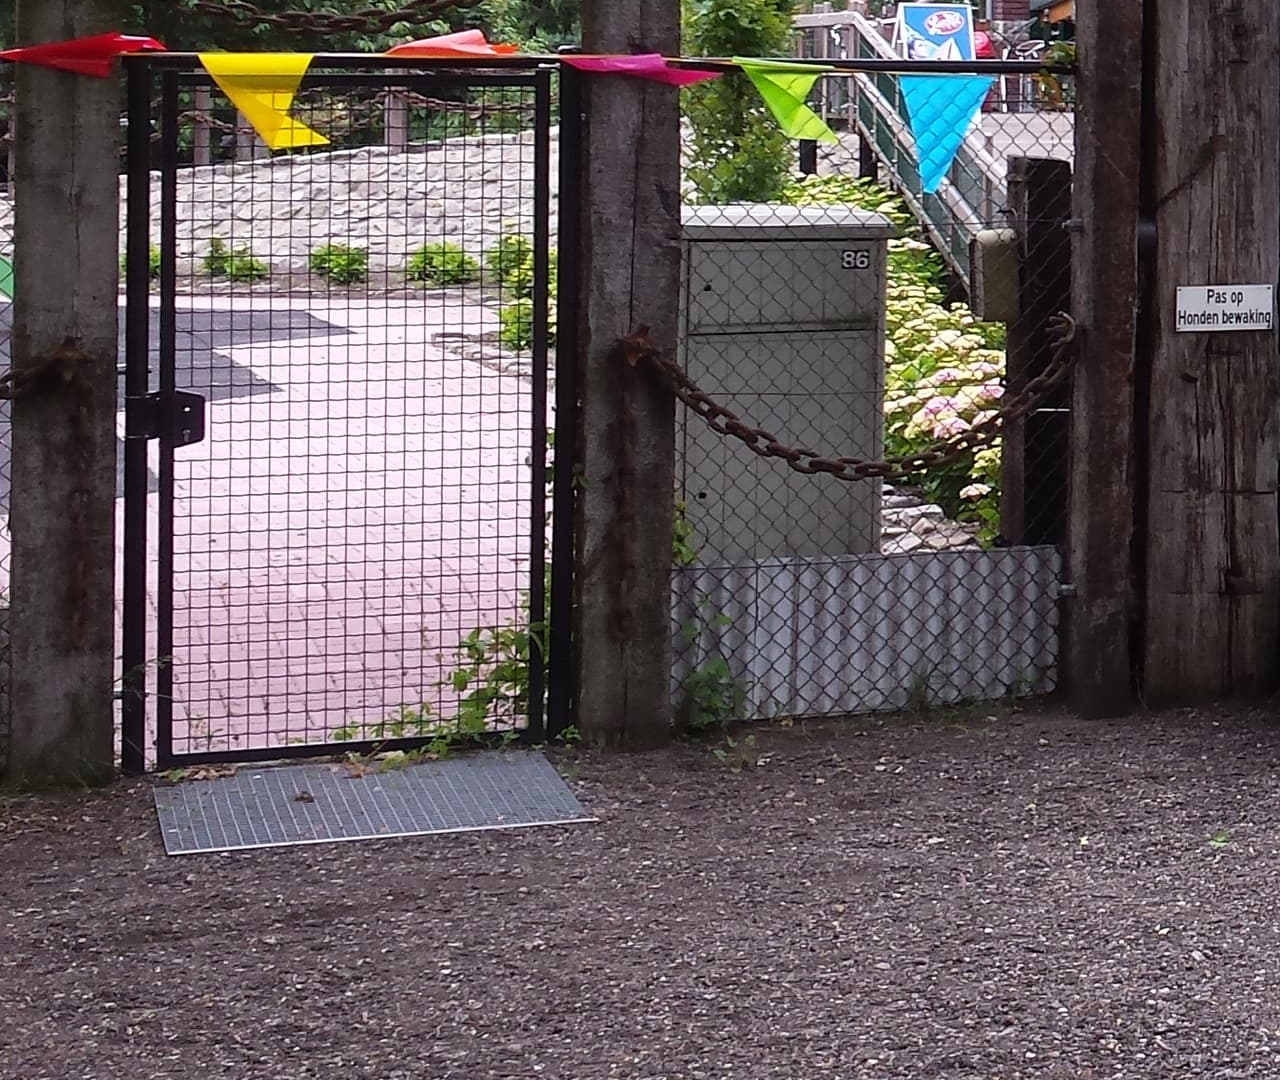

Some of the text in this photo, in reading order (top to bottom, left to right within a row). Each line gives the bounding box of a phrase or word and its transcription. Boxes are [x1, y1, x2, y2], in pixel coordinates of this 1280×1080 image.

[842, 251, 869, 267] 86
[1207, 289, 1243, 306] Pas op
[1178, 309, 1271, 328] Honden bewaking
